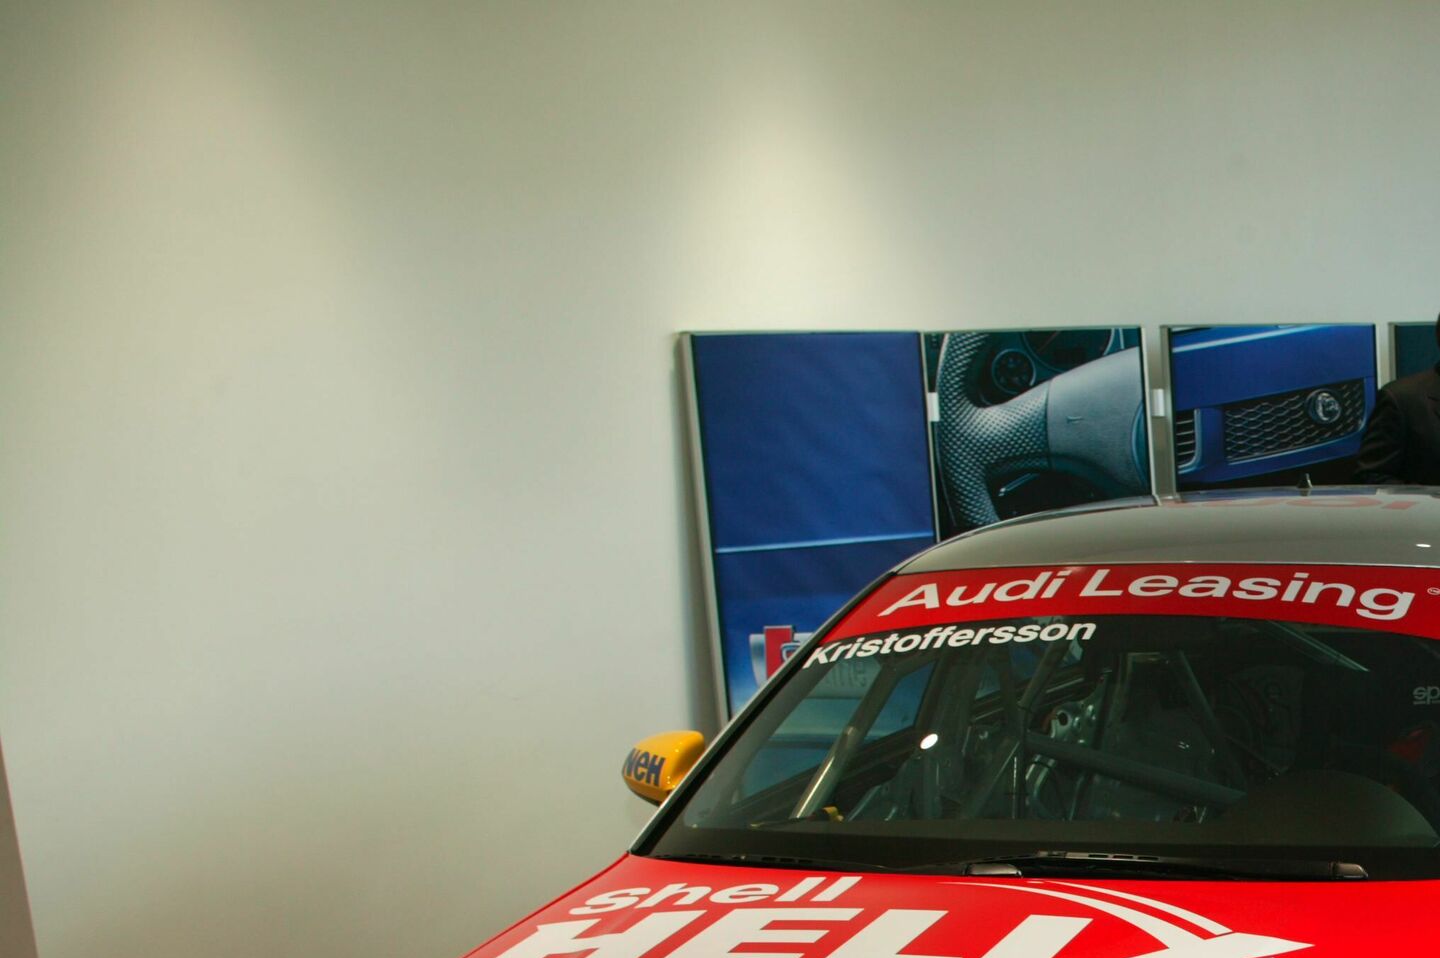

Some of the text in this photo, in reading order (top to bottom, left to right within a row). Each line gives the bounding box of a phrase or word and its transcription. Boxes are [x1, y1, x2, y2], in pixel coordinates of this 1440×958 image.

[877, 568, 1416, 621] Audi Leasing
[802, 618, 1097, 668] Kristoffersson
